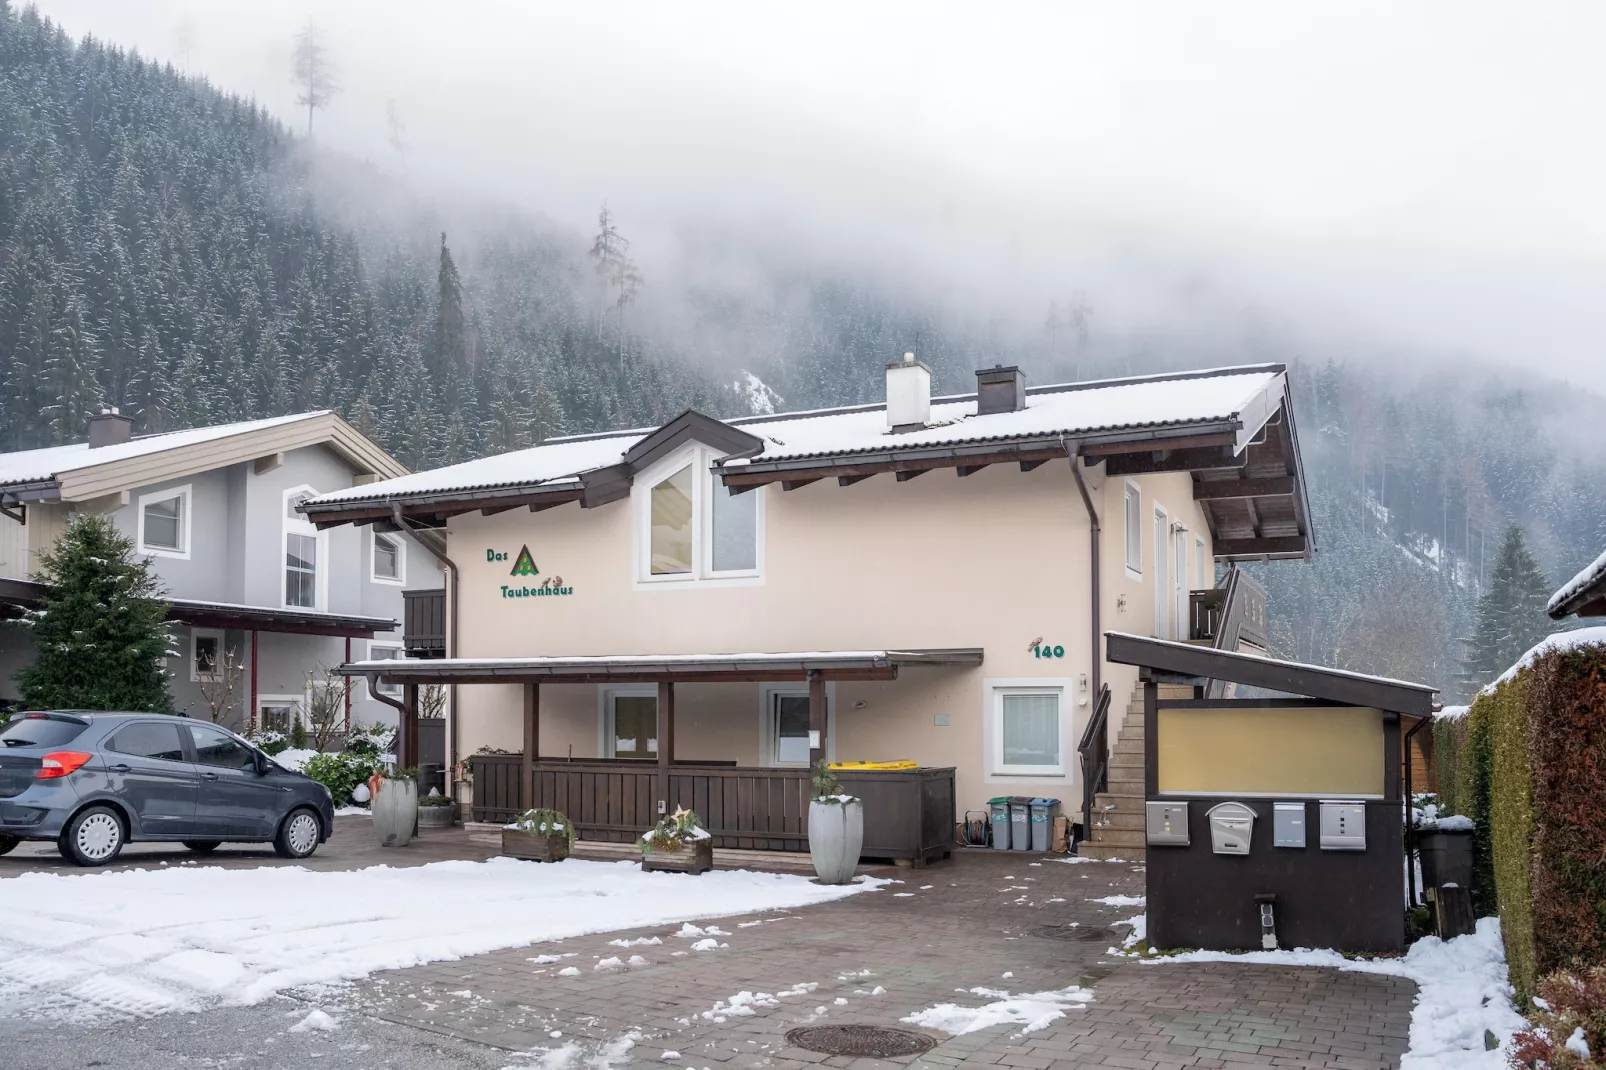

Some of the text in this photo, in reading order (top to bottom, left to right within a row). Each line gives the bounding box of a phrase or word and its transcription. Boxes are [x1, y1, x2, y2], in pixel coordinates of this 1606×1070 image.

[486, 548, 509, 562] Das
[500, 584, 574, 599] Taubenhaus
[1033, 645, 1066, 659] 140
